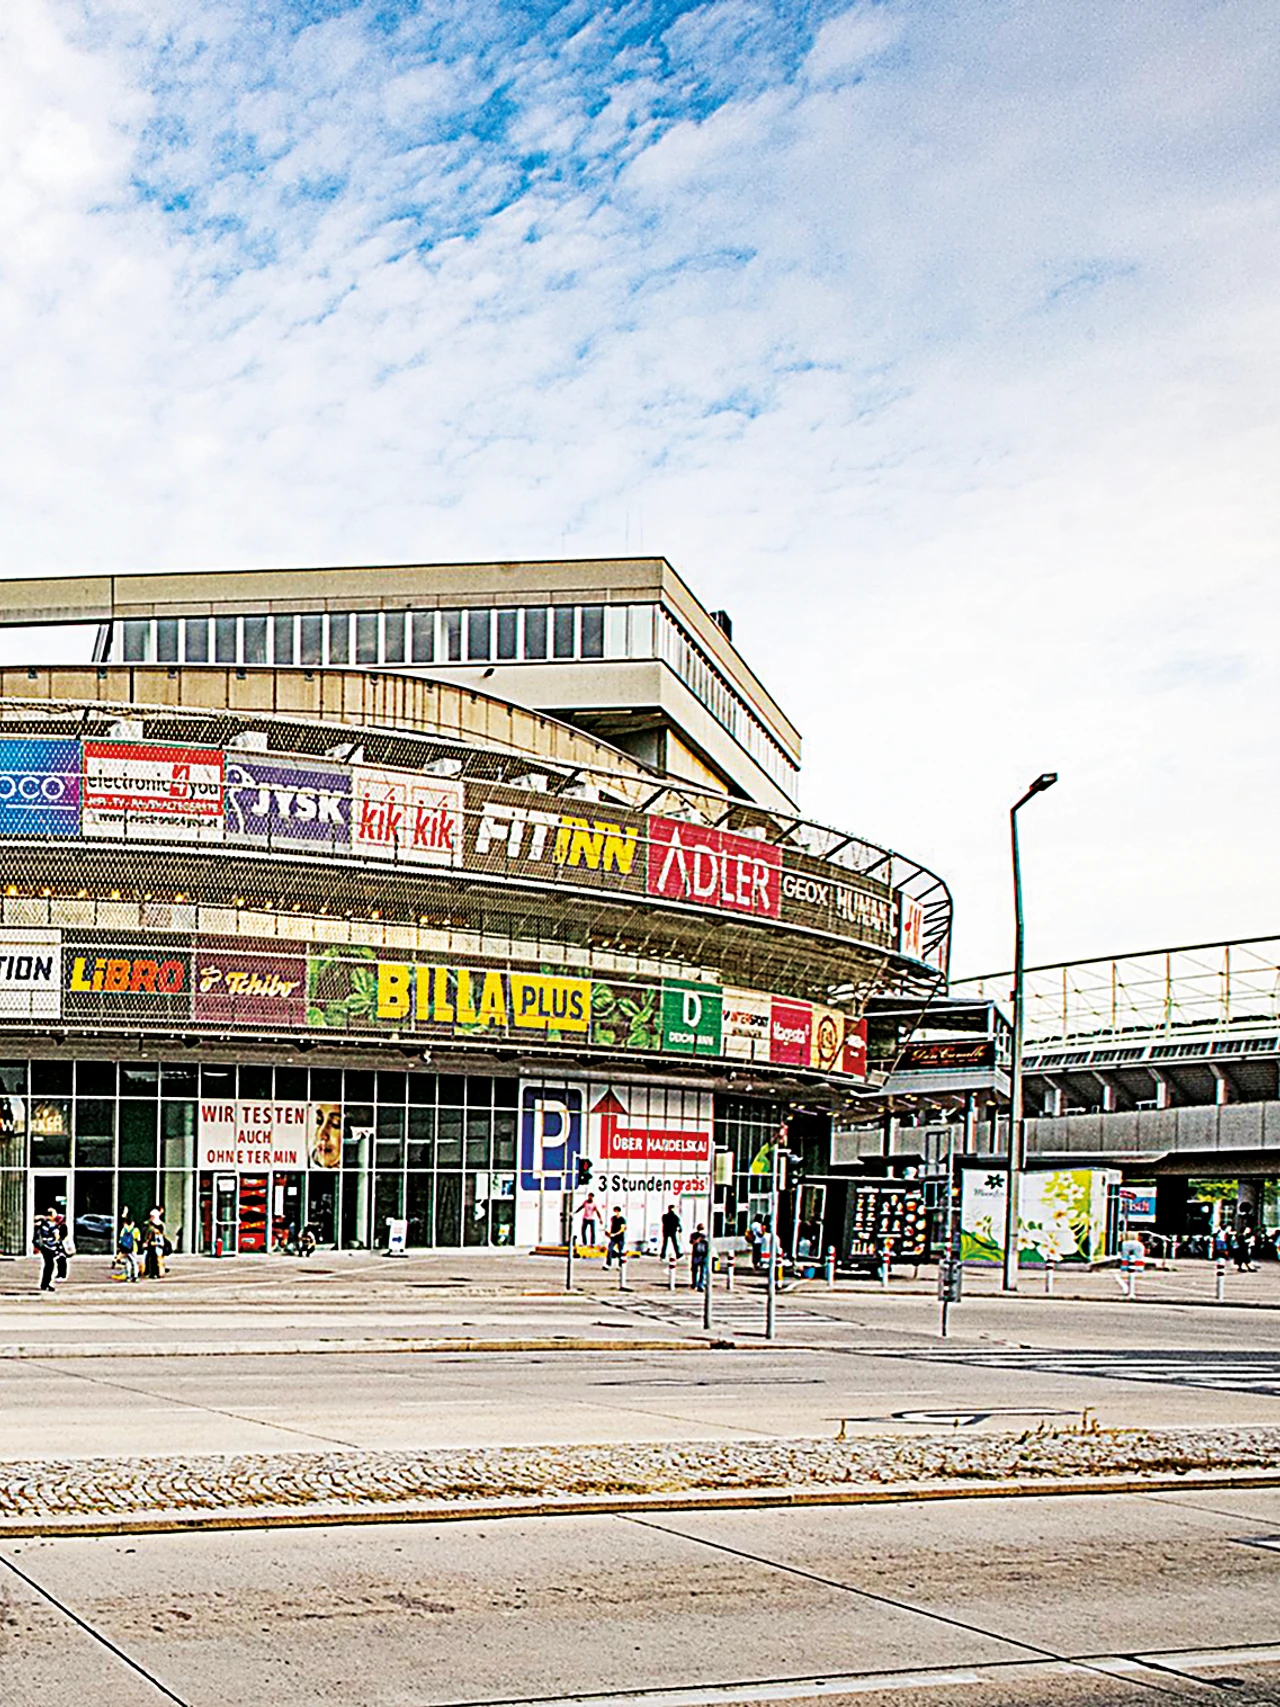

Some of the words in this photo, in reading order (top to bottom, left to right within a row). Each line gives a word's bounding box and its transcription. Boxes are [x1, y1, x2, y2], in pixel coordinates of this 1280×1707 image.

[251, 785, 344, 823] JYSK
[657, 826, 769, 909] ADLER
[783, 875, 829, 907] GEOX
[226, 972, 300, 997] Tchibo
[377, 964, 508, 1026] BILLA
[522, 986, 584, 1019] PLUS
[683, 992, 701, 1027] D
[202, 1105, 234, 1123] WIR
[243, 1107, 304, 1124] TESTEN
[238, 1130, 270, 1144] AUCH
[533, 1099, 571, 1179] P
[207, 1150, 243, 1164] OHNE
[247, 1150, 297, 1164] TERMIN
[598, 1175, 607, 1192] 3
[611, 1175, 671, 1192] Stunden
